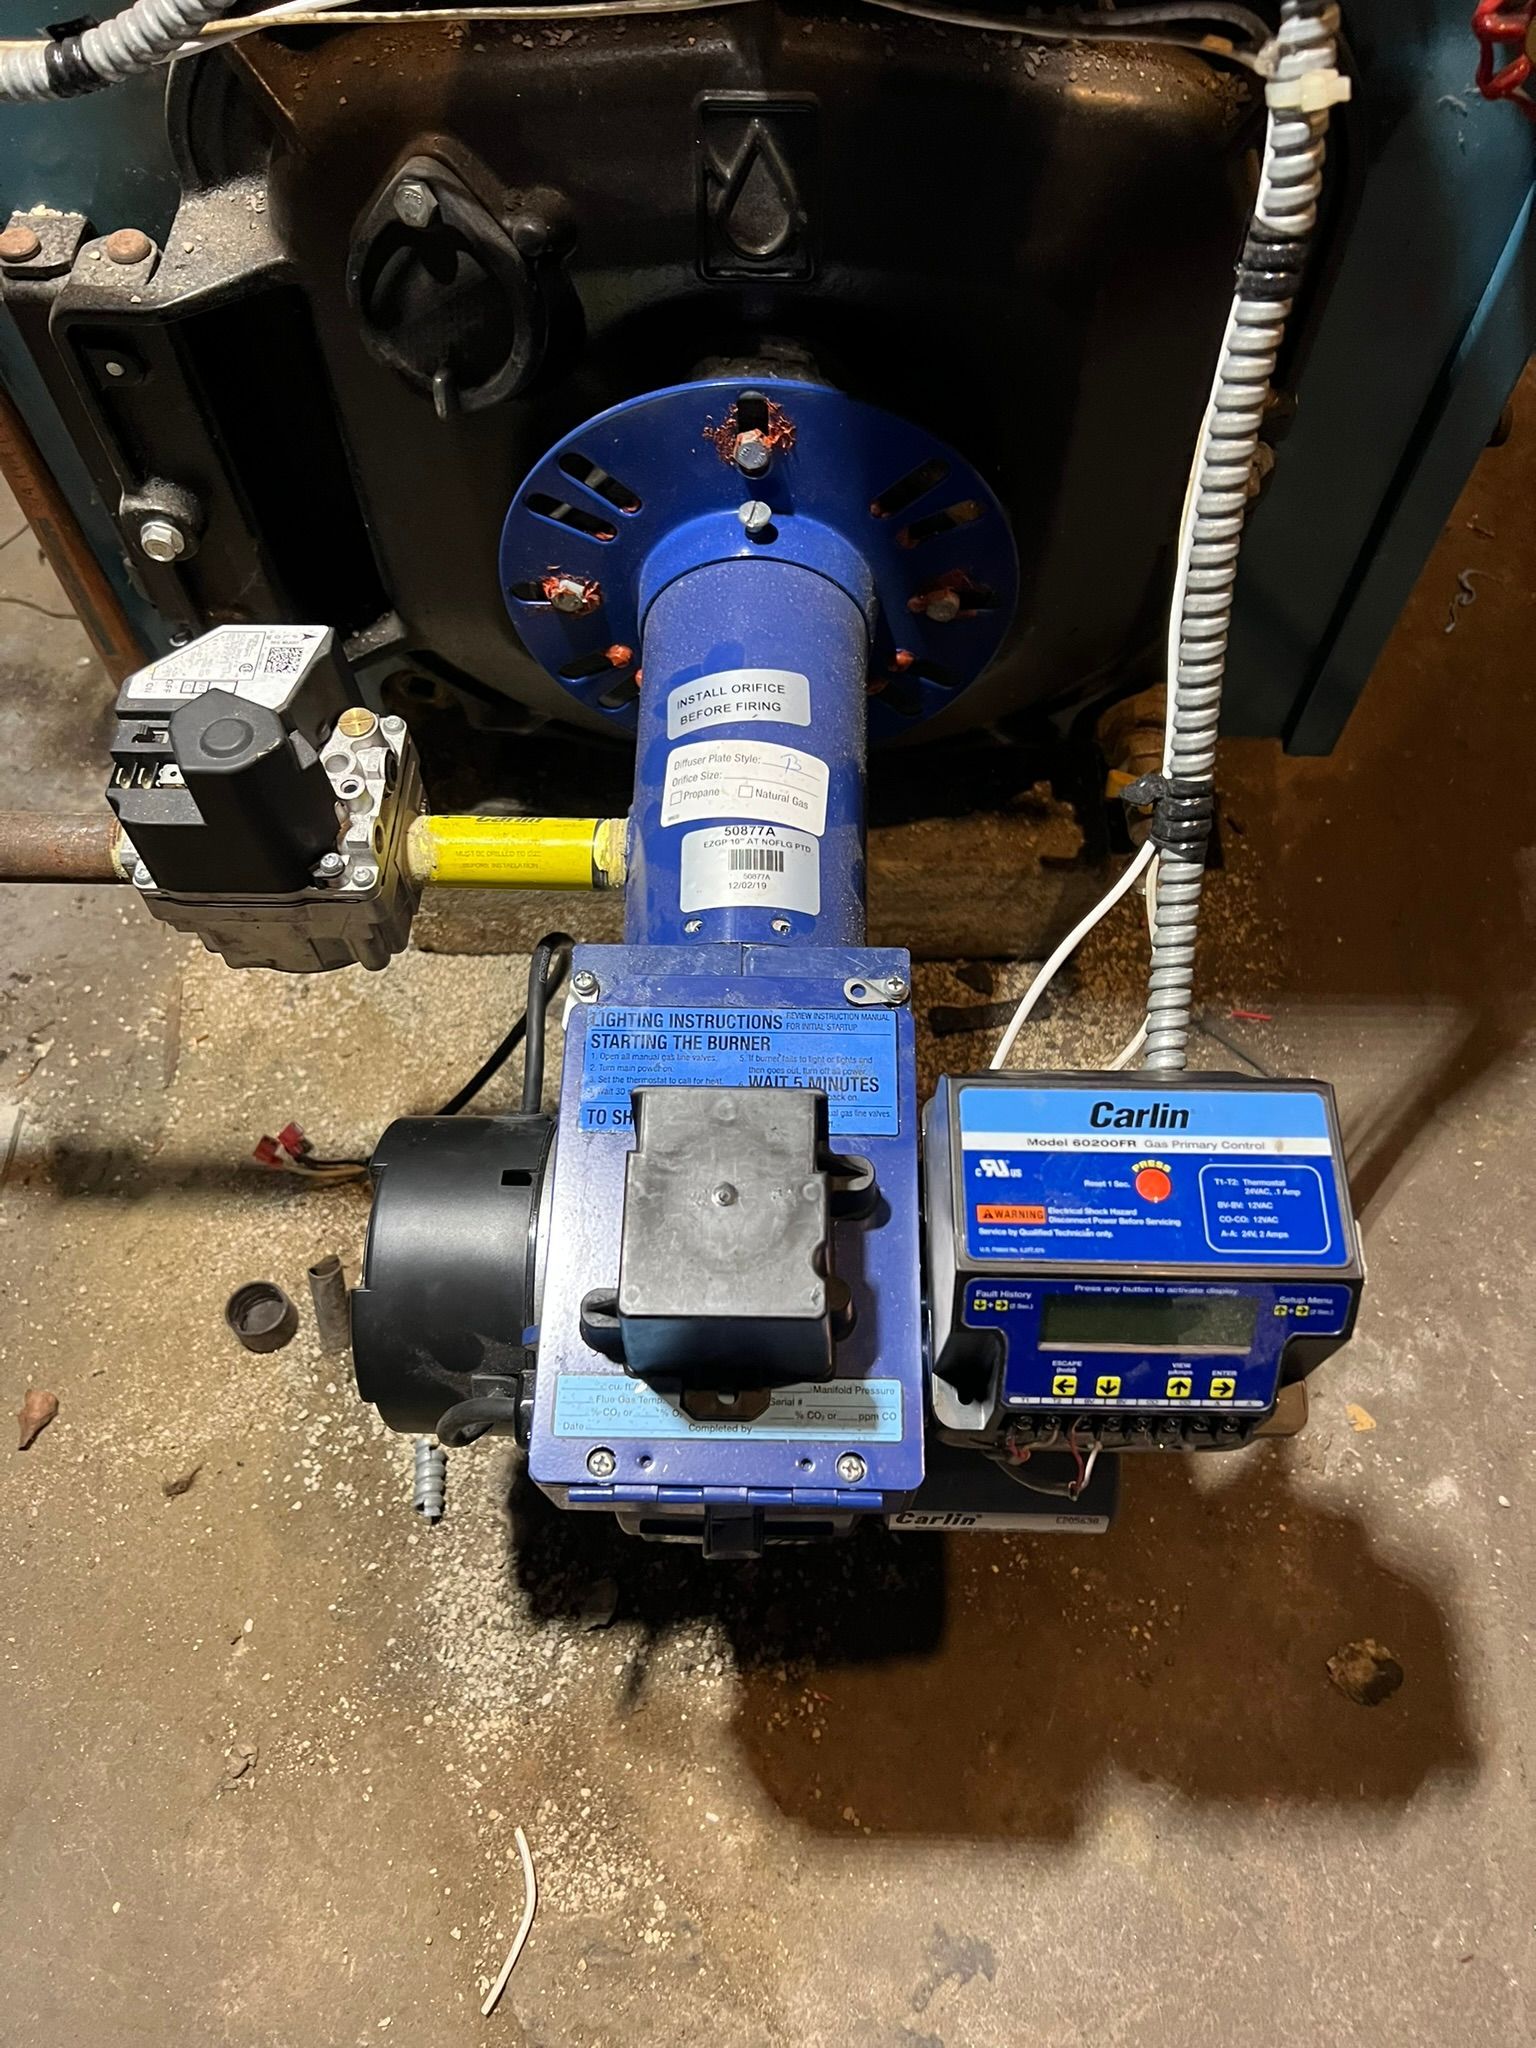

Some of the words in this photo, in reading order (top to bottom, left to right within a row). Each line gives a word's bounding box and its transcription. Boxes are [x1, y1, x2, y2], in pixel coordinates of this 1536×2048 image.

[677, 687, 727, 709] INSTALL
[732, 684, 785, 694] ORIFICE
[680, 704, 731, 725] BEFORE
[736, 702, 782, 712] FIRING
[674, 756, 706, 770] Diffuser
[708, 754, 732, 764] Plate
[734, 754, 761, 764] Style:
[672, 774, 698, 787] Orifice
[700, 771, 722, 780] Size:
[684, 788, 720, 800] Propane
[756, 789, 789, 803] Natural
[792, 797, 808, 809] Gas
[724, 826, 776, 836] 50877A
[704, 840, 728, 848] EZGP
[762, 839, 792, 848] NOFLG
[795, 844, 811, 853] PTD
[592, 1012, 664, 1028] LIGHTING
[670, 1013, 782, 1030] INSTRUCTIONS
[786, 1012, 812, 1020] REVIEW
[813, 1012, 860, 1020] INSTRUCTION
[861, 1013, 890, 1021] MANUAL
[827, 1023, 857, 1031] STARTUP
[591, 1034, 667, 1049] STARTING
[673, 1035, 701, 1050] THE
[708, 1036, 770, 1050] BURNER
[600, 1053, 619, 1062] Open
[756, 1054, 780, 1063] burner
[749, 1066, 764, 1074] then
[802, 1067, 818, 1075] turn
[820, 1067, 830, 1075] off
[598, 1076, 611, 1084] Set
[613, 1076, 624, 1084] the
[749, 1076, 789, 1088] WAIT
[794, 1076, 802, 1088] 5
[808, 1077, 879, 1092] MINUTES
[587, 1109, 606, 1124] TO
[1089, 1101, 1190, 1128] Carlin
[1026, 1138, 1068, 1147] Model
[1072, 1139, 1137, 1148] 60200FR
[1144, 1140, 1168, 1148] Gas
[1172, 1140, 1217, 1151] Primary
[1221, 1140, 1265, 1150] Control
[1132, 1160, 1171, 1173] PRESS
[1084, 1180, 1104, 1188] Reset
[1114, 1180, 1130, 1188] Sec.
[1243, 1179, 1286, 1187] Thermostat
[1282, 1189, 1301, 1197] Amp
[995, 1210, 1044, 1219] WARNING
[1048, 1207, 1083, 1215] Electrical
[1049, 1216, 1092, 1224] Disconnect
[1093, 1217, 1117, 1225] Power
[1146, 1219, 1181, 1227] Servicing
[978, 1228, 1007, 1236] Service
[1008, 1229, 1018, 1237] by
[1019, 1229, 1052, 1237] Qualified
[1054, 1229, 1094, 1238] Technician
[1266, 1231, 1289, 1239] Amps
[1000, 1290, 1032, 1299] History
[1206, 1288, 1239, 1296] display
[1280, 1296, 1305, 1304] Setup
[813, 1386, 852, 1395] Manifold
[855, 1386, 894, 1395] Pressure
[596, 1396, 615, 1404] Flue
[618, 1395, 636, 1404] Gas
[770, 1398, 795, 1406] Serial
[827, 1412, 836, 1420] or
[858, 1412, 879, 1422] ppm
[882, 1412, 897, 1421] CO
[563, 1422, 584, 1430] Date
[688, 1424, 738, 1433] Completed
[741, 1424, 752, 1434] by
[896, 1512, 977, 1526] Carlin
